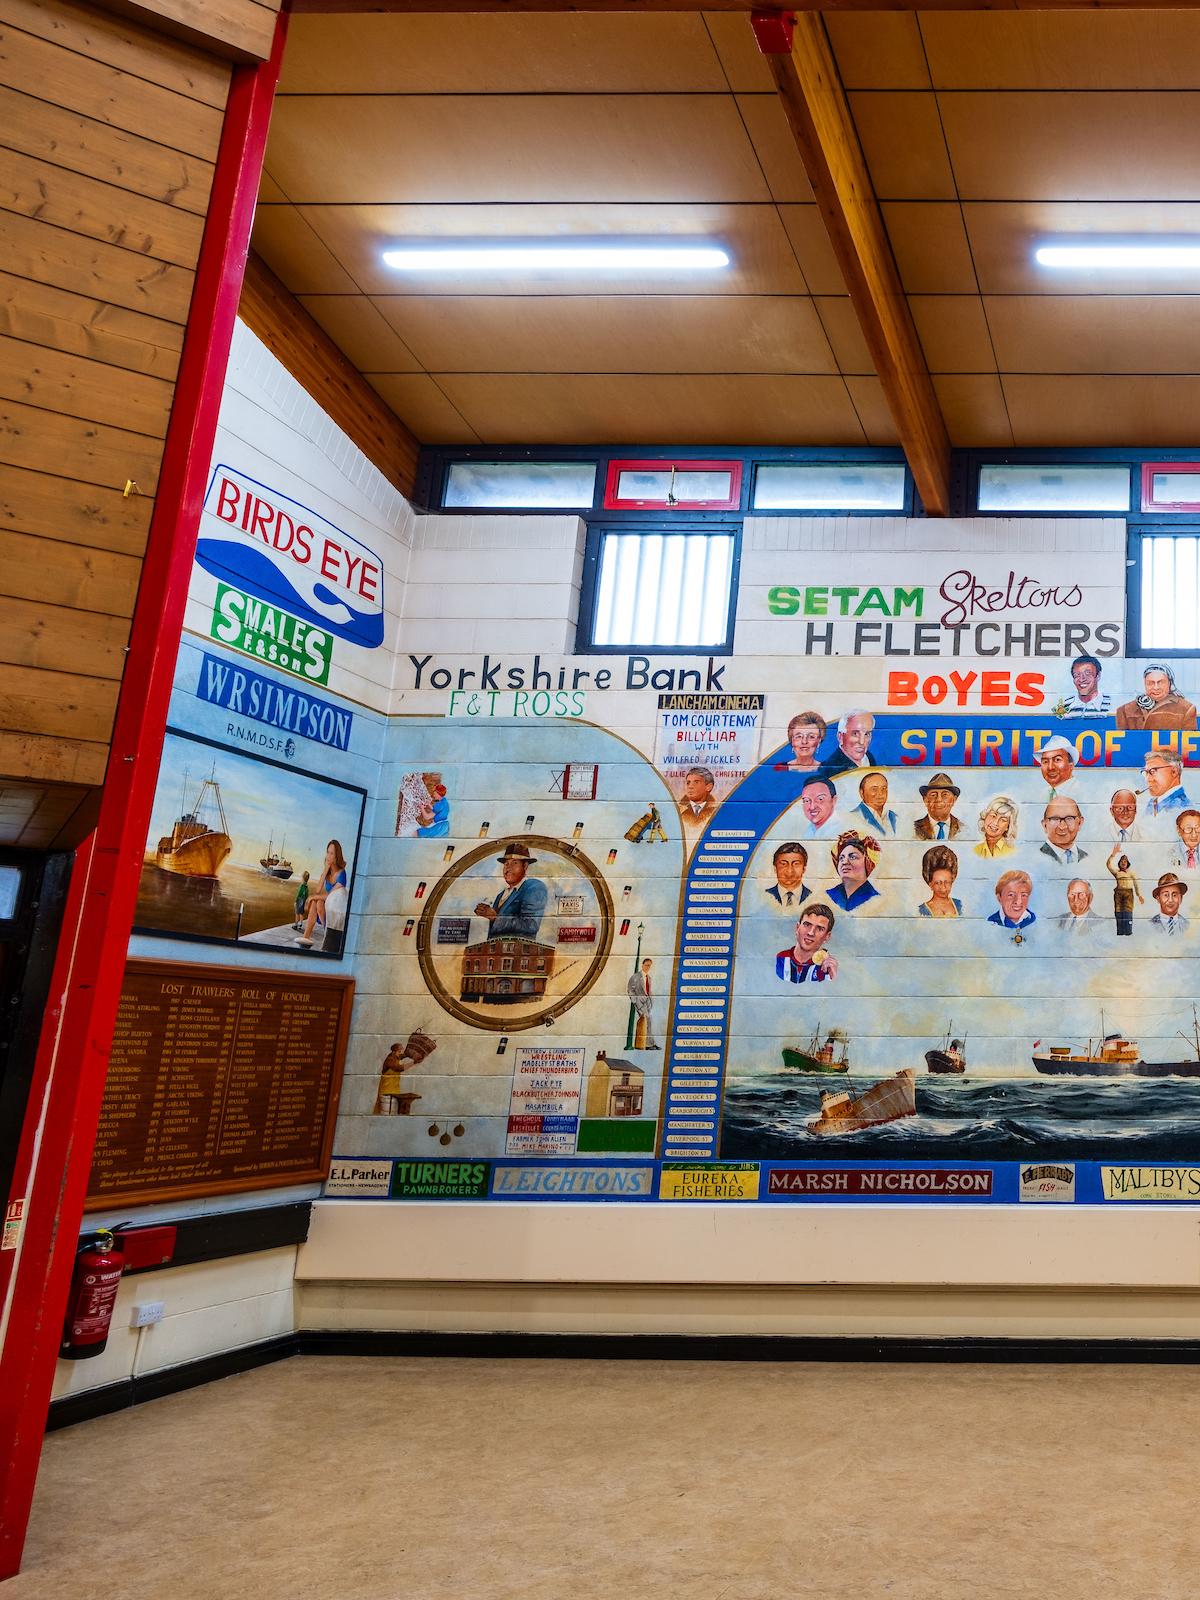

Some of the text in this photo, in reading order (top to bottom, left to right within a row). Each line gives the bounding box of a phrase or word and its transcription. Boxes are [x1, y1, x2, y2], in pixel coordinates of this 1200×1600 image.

[216, 478, 379, 602] BIRDS EYE
[767, 586, 925, 617] SETAM
[216, 590, 326, 679] SMALES
[805, 622, 1121, 656] H. FLETCHERS
[409, 655, 726, 691] Yorkshire Bank
[887, 670, 1046, 707] BOYES
[513, 691, 585, 717] ROSS
[718, 695, 760, 710] CINEMA
[662, 714, 758, 727] TOM COURTENAY
[677, 731, 736, 742] BILLY LIAR
[695, 743, 719, 751] WITH
[901, 730, 1052, 767] SPIRIT
[1075, 730, 1126, 767] OF
[663, 755, 741, 764] WILFRED PICKLES
[160, 984, 184, 995] LOST
[192, 985, 235, 997] TRAWLERS
[241, 988, 261, 999] ROLL
[265, 991, 277, 1000] OF
[398, 1163, 485, 1184] TURNERS
[499, 1171, 646, 1194] LEIGHTONS
[682, 1173, 738, 1184] EUREKA
[770, 1173, 991, 1191] MARSH NICHOLSON
[403, 1185, 479, 1195] PAWNBROKERS
[673, 1185, 744, 1197] FISHERIES
